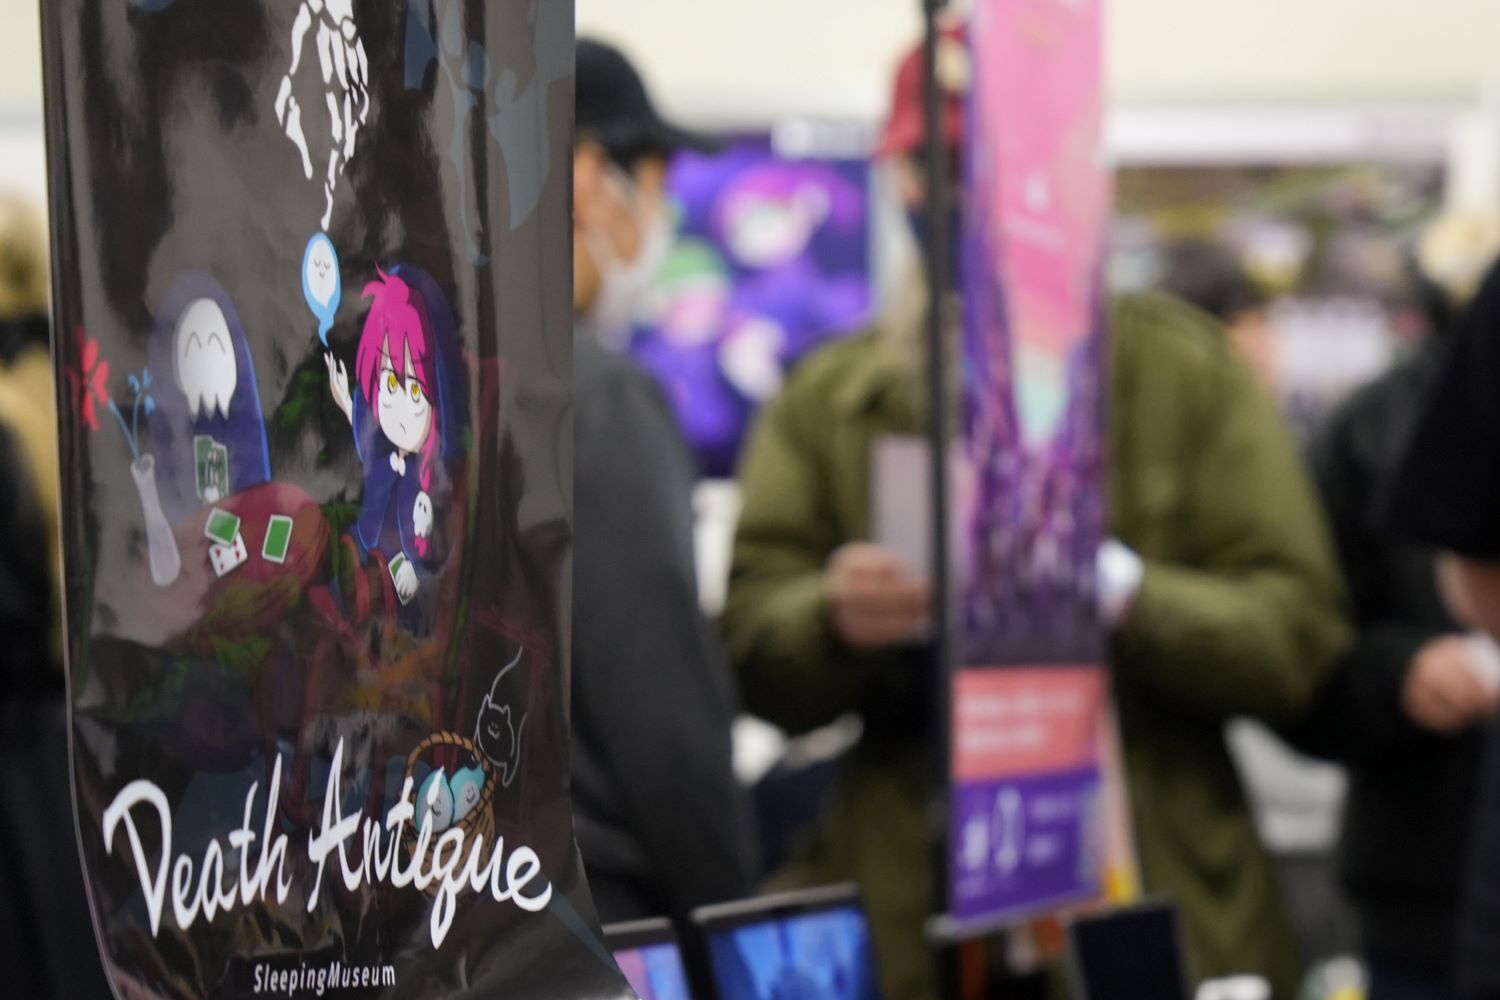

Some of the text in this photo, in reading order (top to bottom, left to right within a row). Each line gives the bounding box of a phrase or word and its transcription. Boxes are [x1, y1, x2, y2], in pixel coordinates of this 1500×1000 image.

[103, 736, 553, 949] Death Antique
[253, 961, 396, 998] SleepingMuseum
